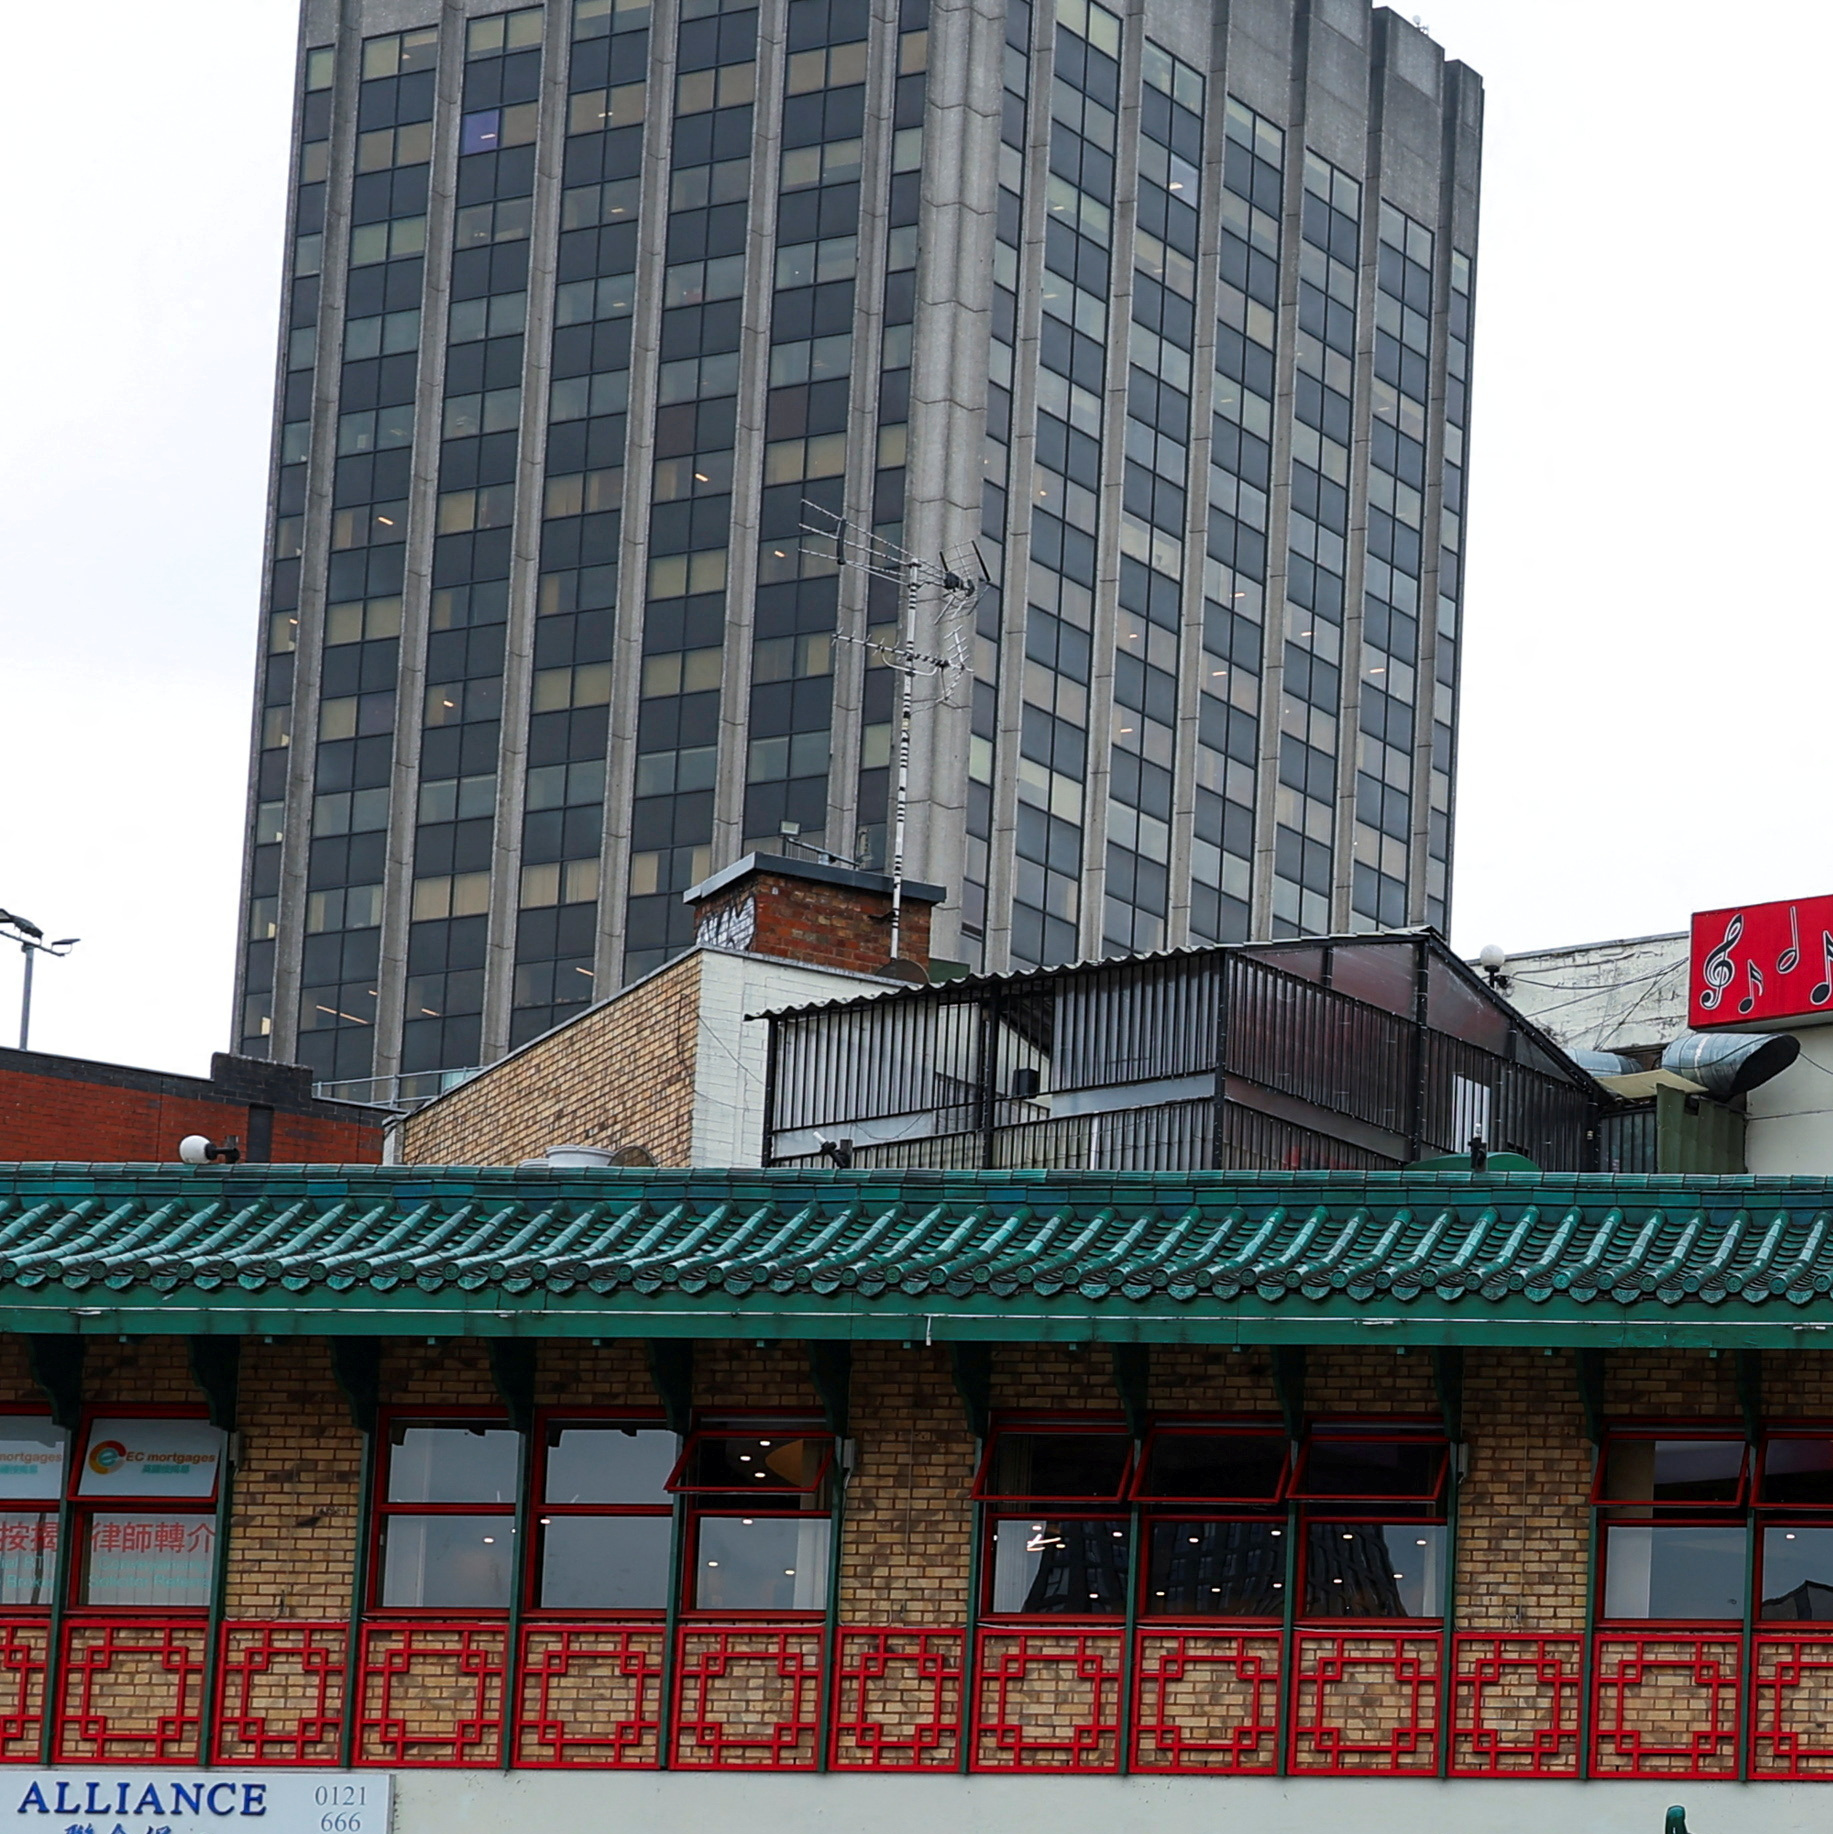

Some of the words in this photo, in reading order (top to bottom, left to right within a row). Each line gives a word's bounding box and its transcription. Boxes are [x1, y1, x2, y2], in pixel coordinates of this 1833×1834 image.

[126, 1452, 144, 1462] EC
[147, 1452, 216, 1464] mortgages
[90, 1522, 216, 1554] 律師轉介
[17, 1780, 268, 1817] ALLIANCE
[314, 1786, 367, 1807] 0121
[320, 1812, 362, 1833] 666
